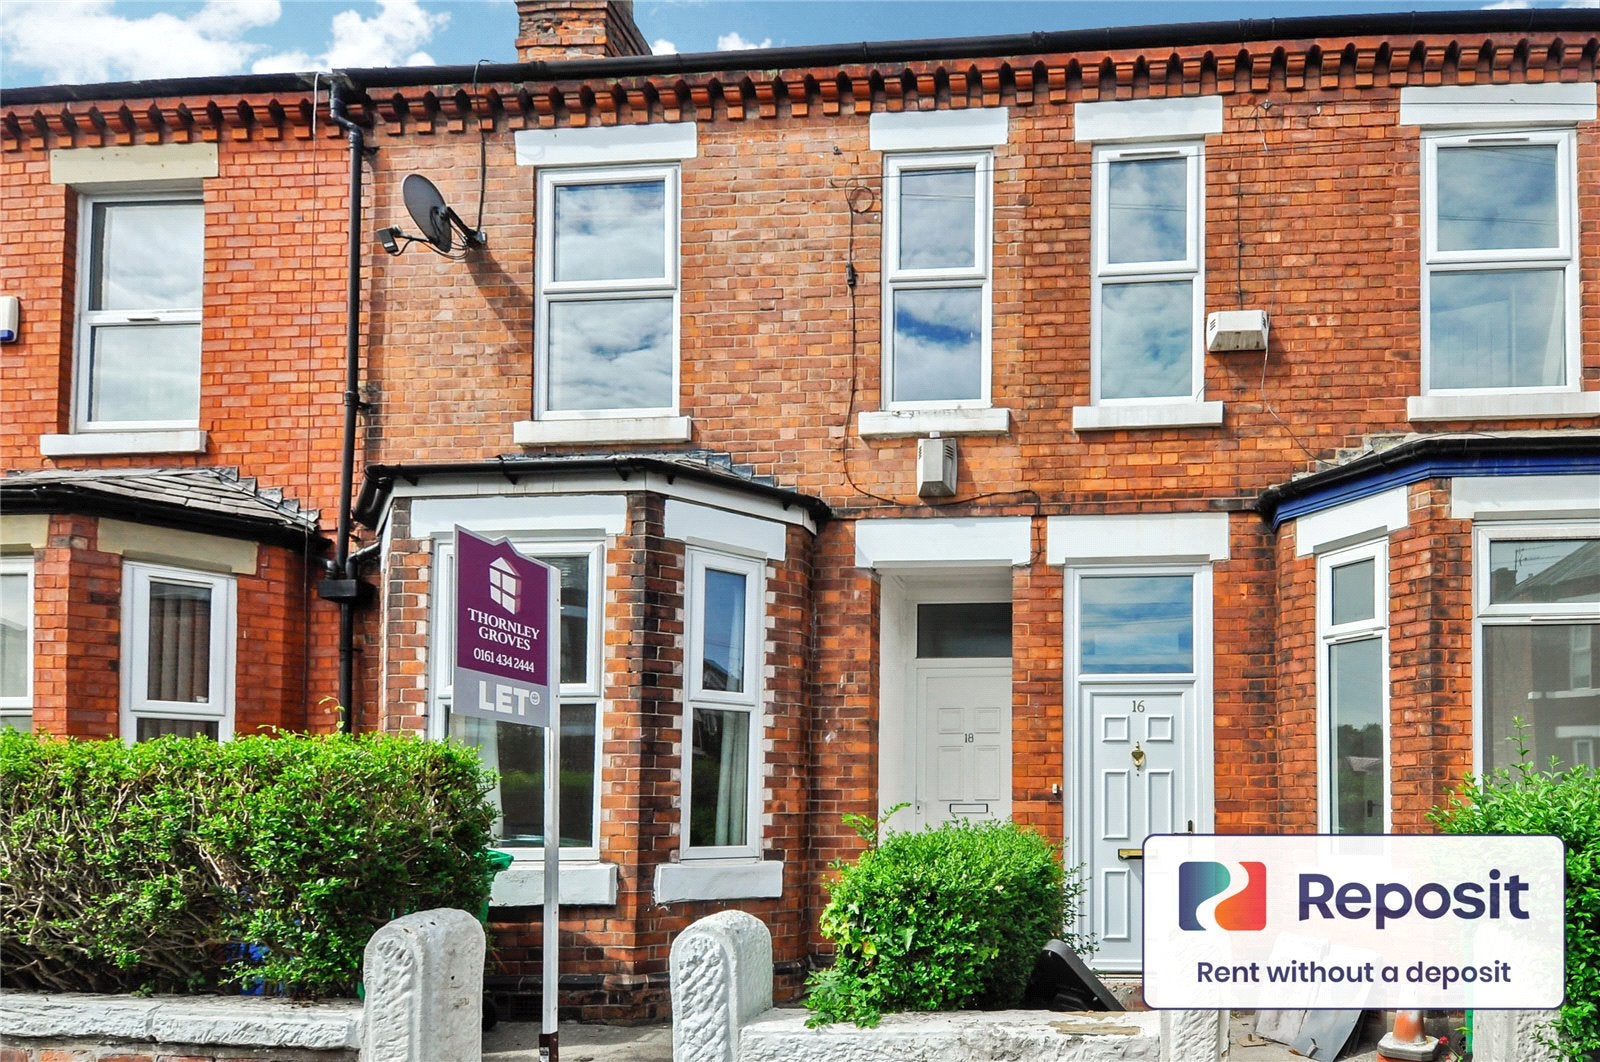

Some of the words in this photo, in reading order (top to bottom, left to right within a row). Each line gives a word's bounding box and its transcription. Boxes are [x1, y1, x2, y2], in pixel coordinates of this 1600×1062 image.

[467, 607, 540, 640] THORNLEY
[478, 626, 531, 651] GROVES
[473, 647, 495, 663] 0161
[496, 653, 513, 668] 434
[513, 657, 535, 673] 2444
[478, 680, 530, 716] LET
[1132, 700, 1145, 713] 16
[964, 733, 975, 744] 18
